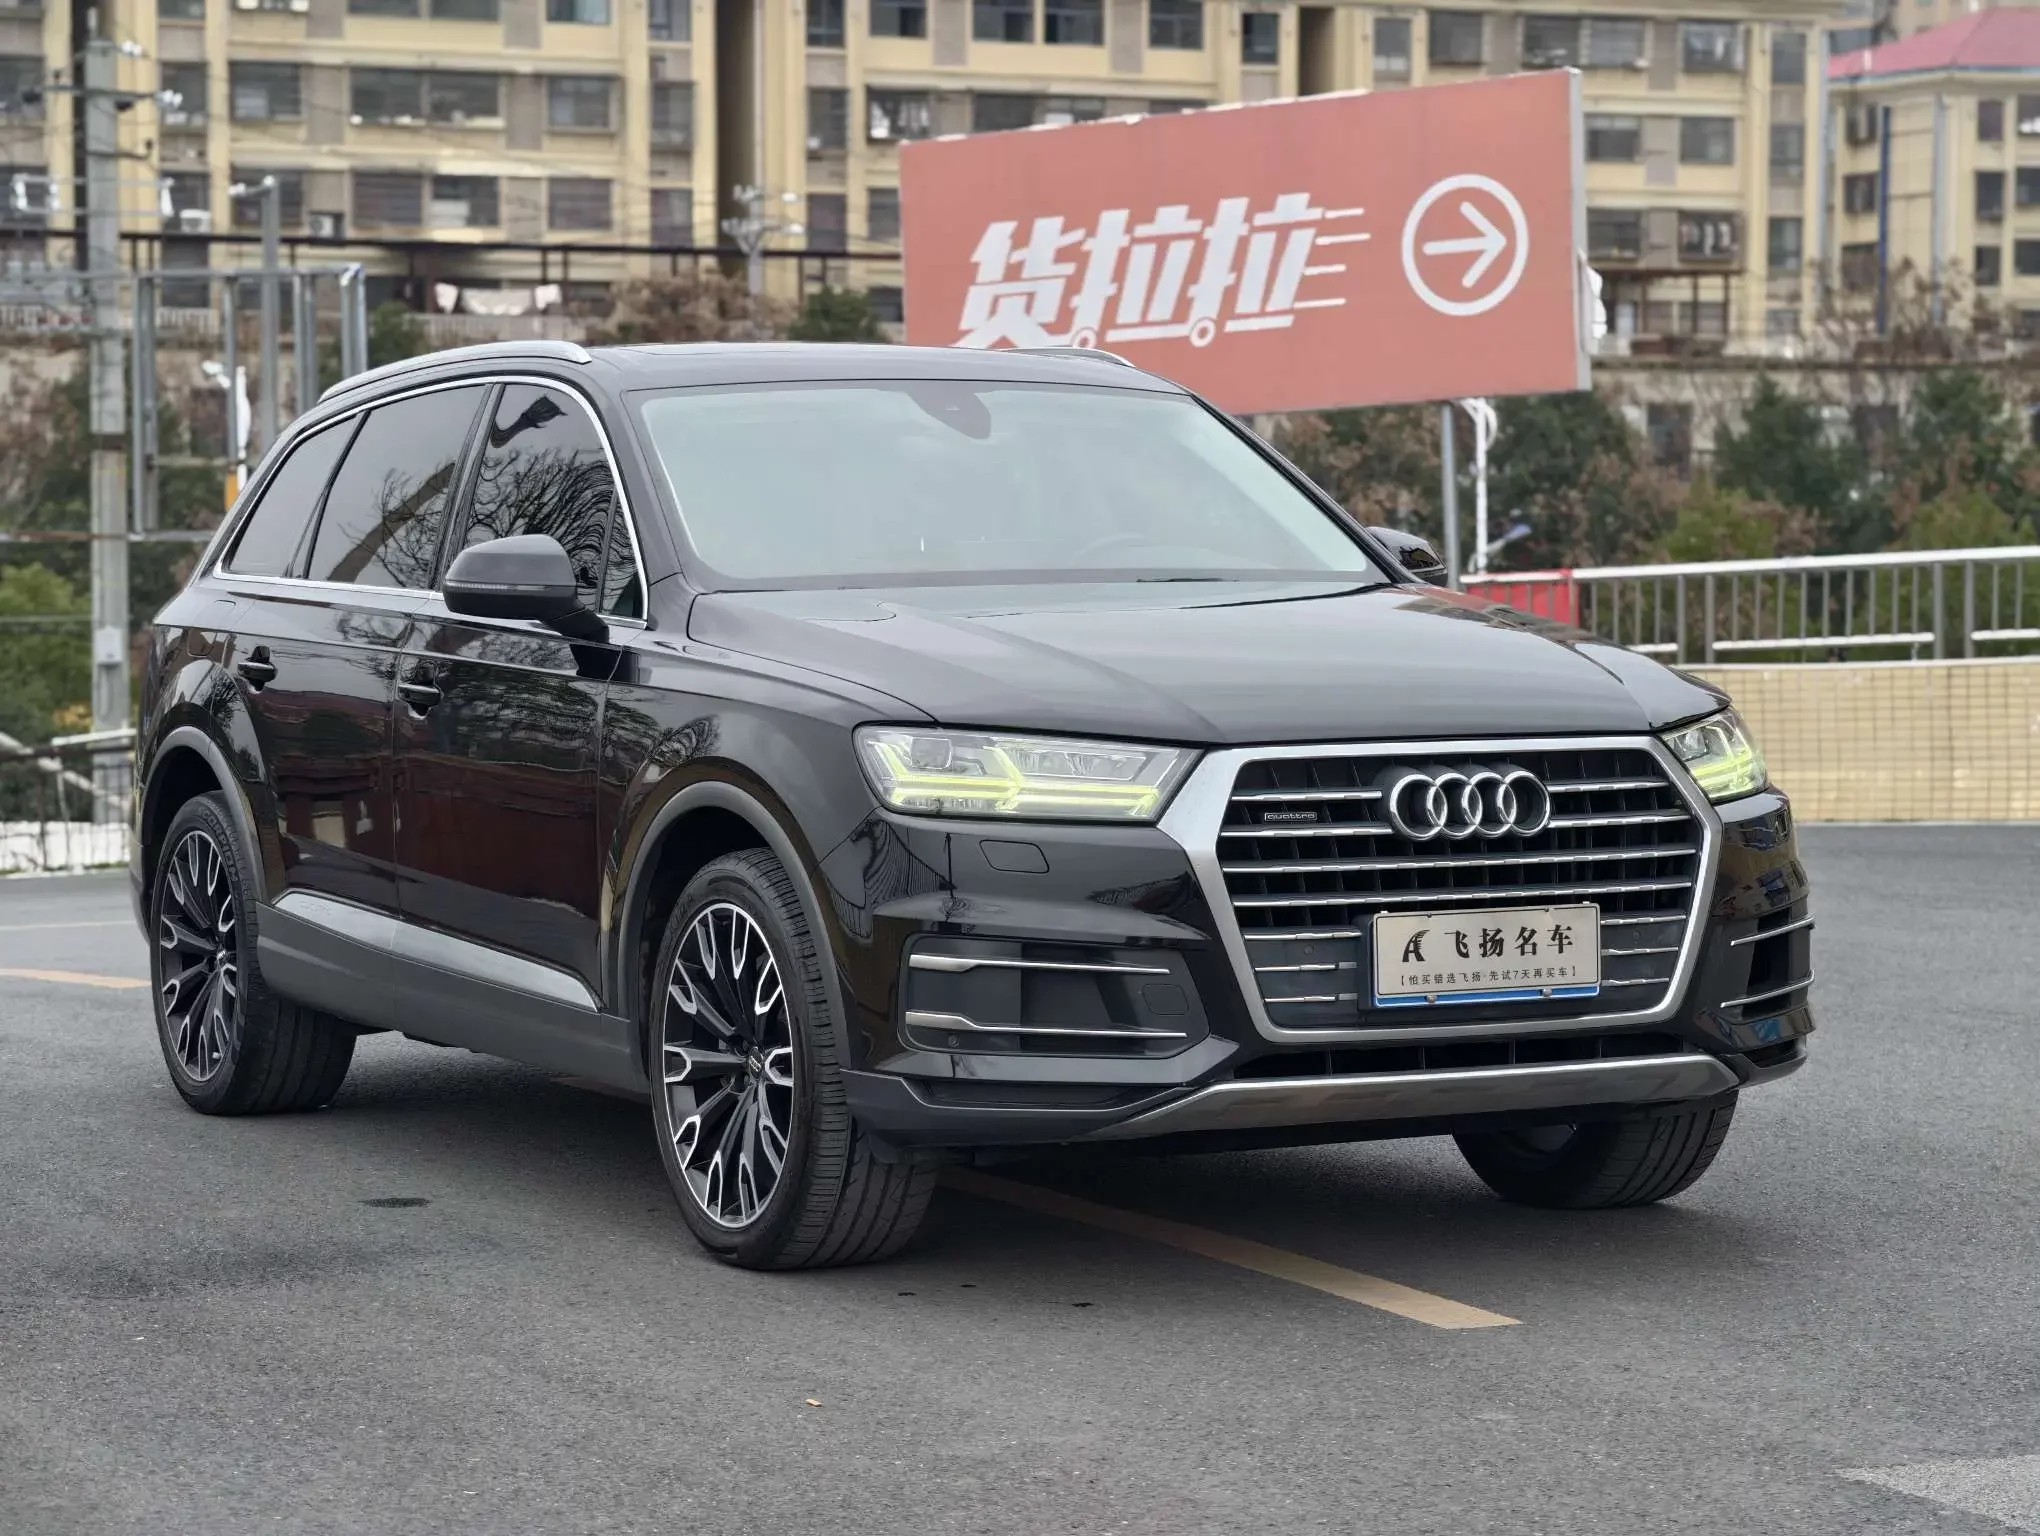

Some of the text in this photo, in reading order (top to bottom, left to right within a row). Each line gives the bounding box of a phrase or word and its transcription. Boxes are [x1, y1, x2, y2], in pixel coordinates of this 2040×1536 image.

[949, 193, 1328, 349] 货拉拉
[1266, 813, 1316, 821] quattro
[1443, 924, 1573, 959] 飞扬名车
